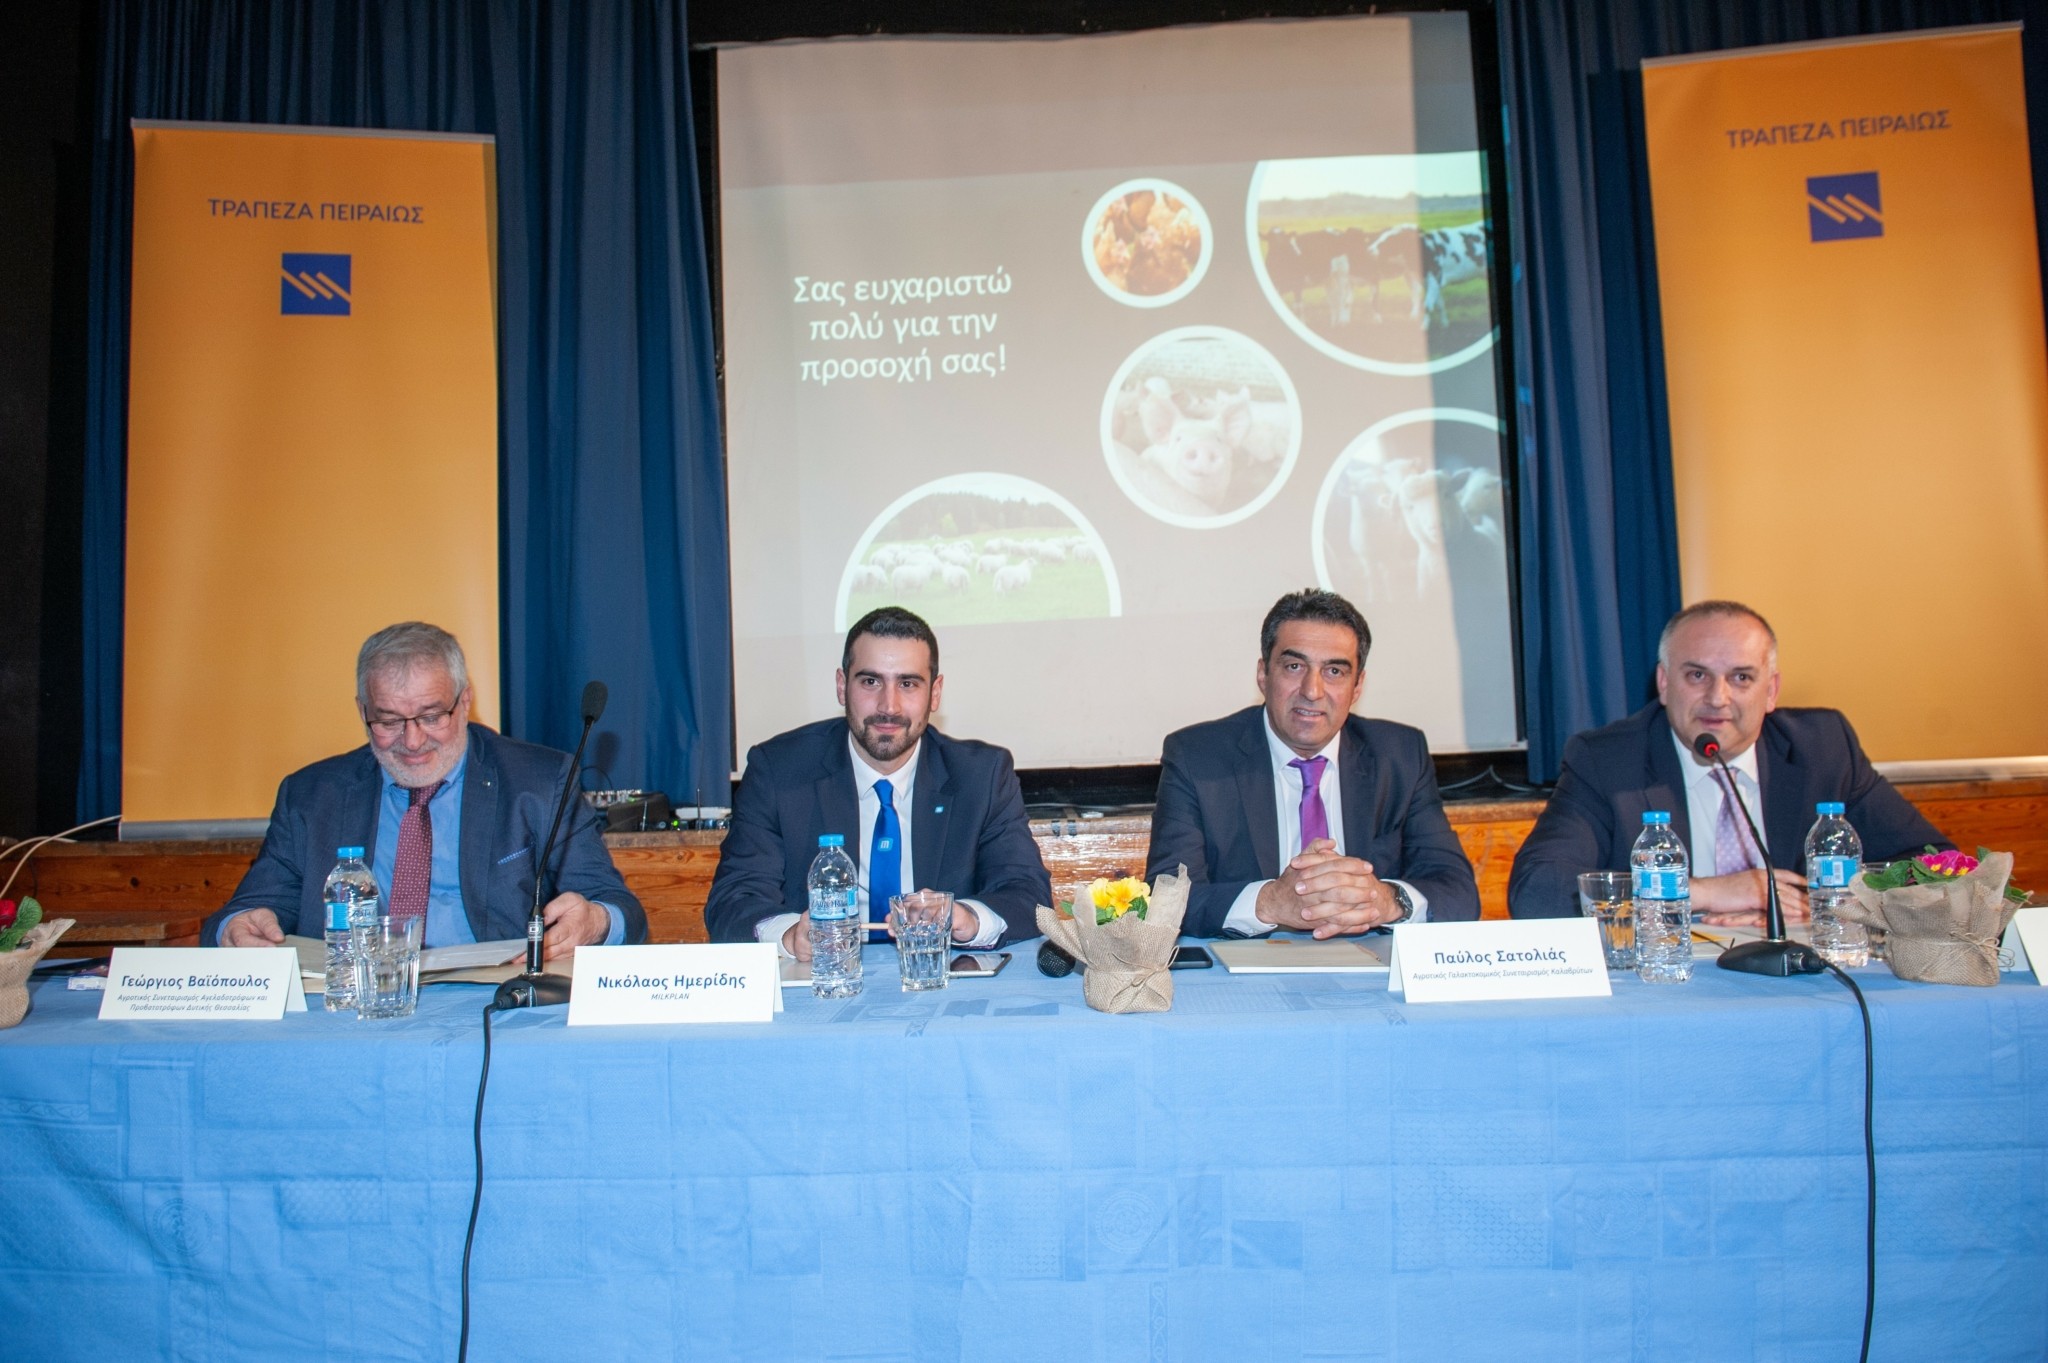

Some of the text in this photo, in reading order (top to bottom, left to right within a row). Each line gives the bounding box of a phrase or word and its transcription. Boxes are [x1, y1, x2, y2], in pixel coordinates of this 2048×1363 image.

[1726, 109, 1952, 149] ΤΡΑΠΕΖΑ ΠΕΙΡΑΙΩΣ
[208, 198, 424, 224] ΤΡΑΠΕΖΑ ΠΕΙΡΑΙΩΣ
[793, 265, 1012, 307] Σας ευχαριστώ
[809, 311, 997, 344] πολύ για την
[800, 343, 1007, 386] προσοχή σας!
[1434, 947, 1567, 966] Παύλος Σατολιάς
[121, 974, 271, 990] Γεώργιος Βαϊόπουλος
[598, 972, 746, 990] Νικόλαος Ημερίδης
[1413, 972, 1447, 981] Αγροτικός
[1502, 968, 1550, 978] Συνεταιρισμός
[117, 993, 151, 1002] Αγροτικός
[152, 993, 199, 1002] Συνεταιρισμός
[200, 993, 256, 1002] Αγελαδοτρόφων
[651, 992, 690, 1001] MILKPLAN
[186, 1003, 213, 1012] Δυτικής
